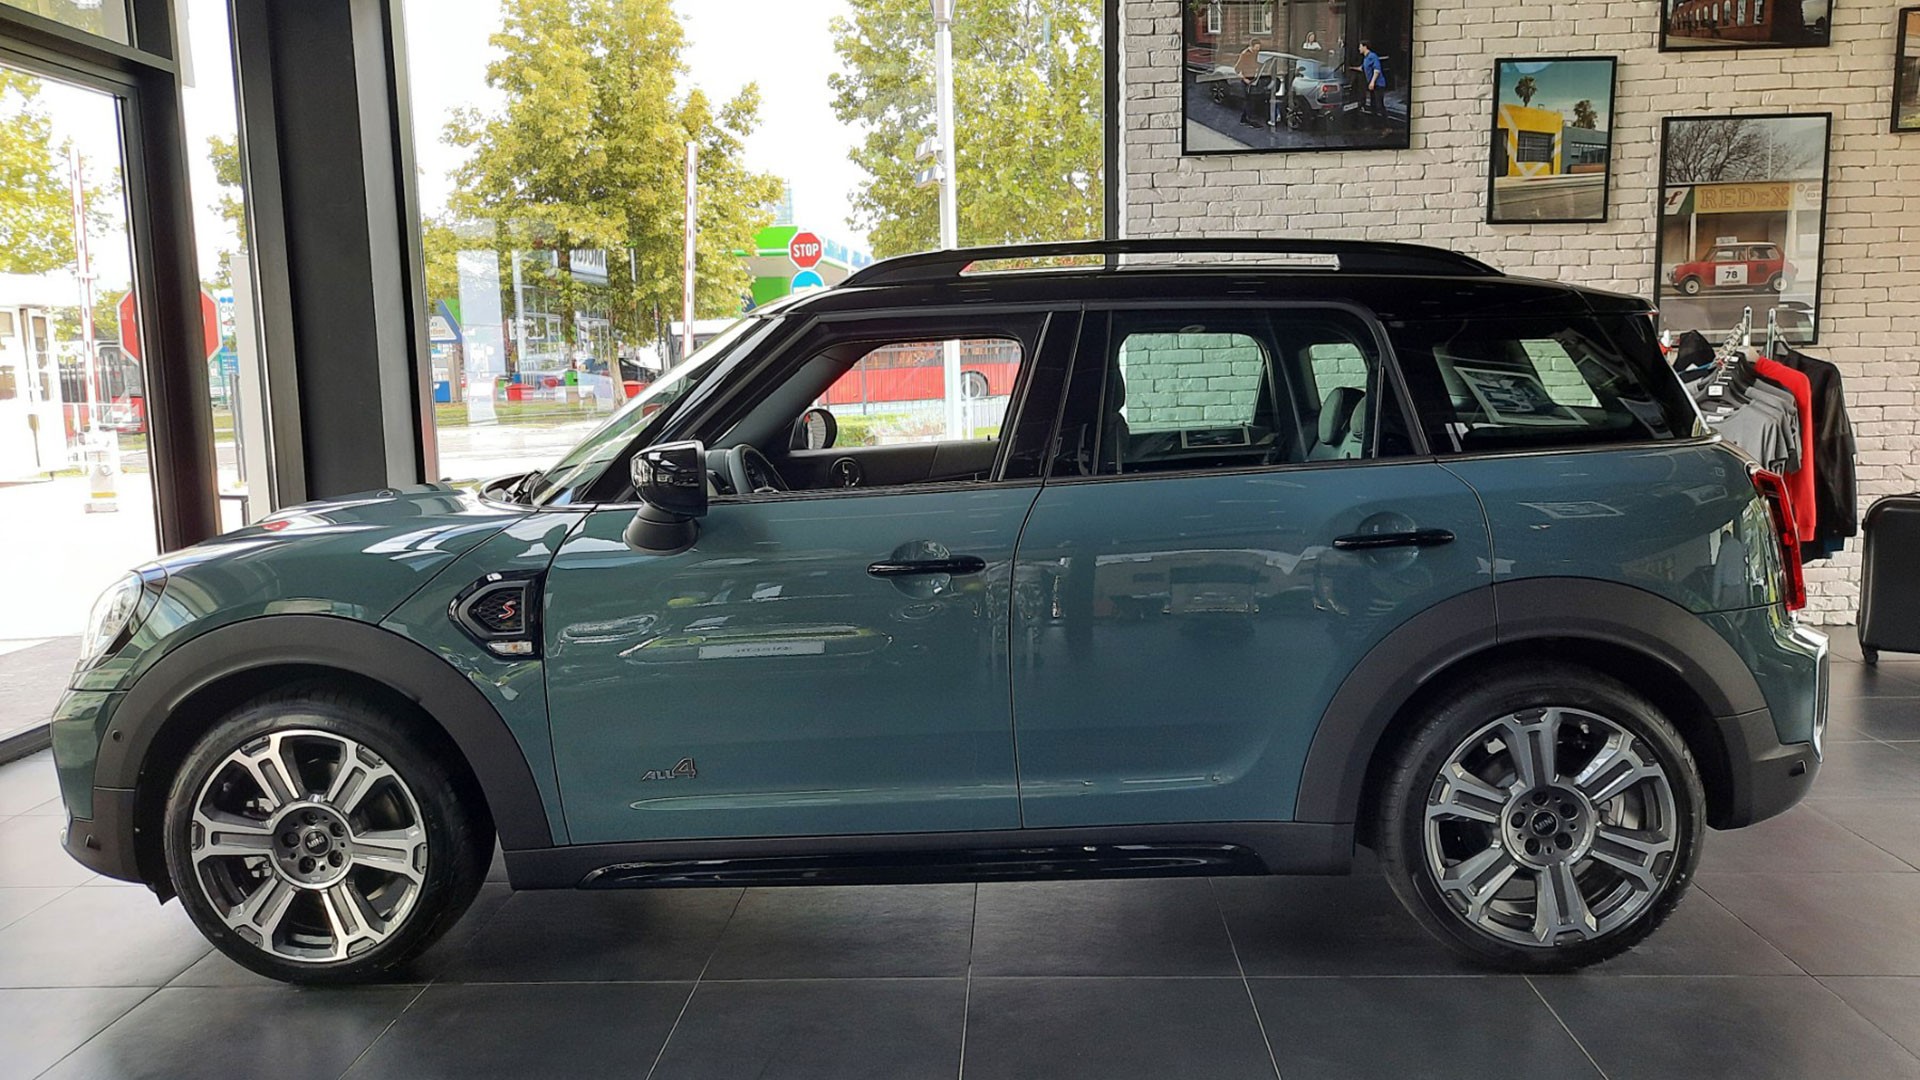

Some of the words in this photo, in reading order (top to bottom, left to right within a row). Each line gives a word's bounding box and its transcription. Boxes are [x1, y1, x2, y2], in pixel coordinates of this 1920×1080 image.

[792, 243, 819, 258] STOP
[1725, 270, 1738, 279] 78
[1534, 815, 1554, 831] MINI
